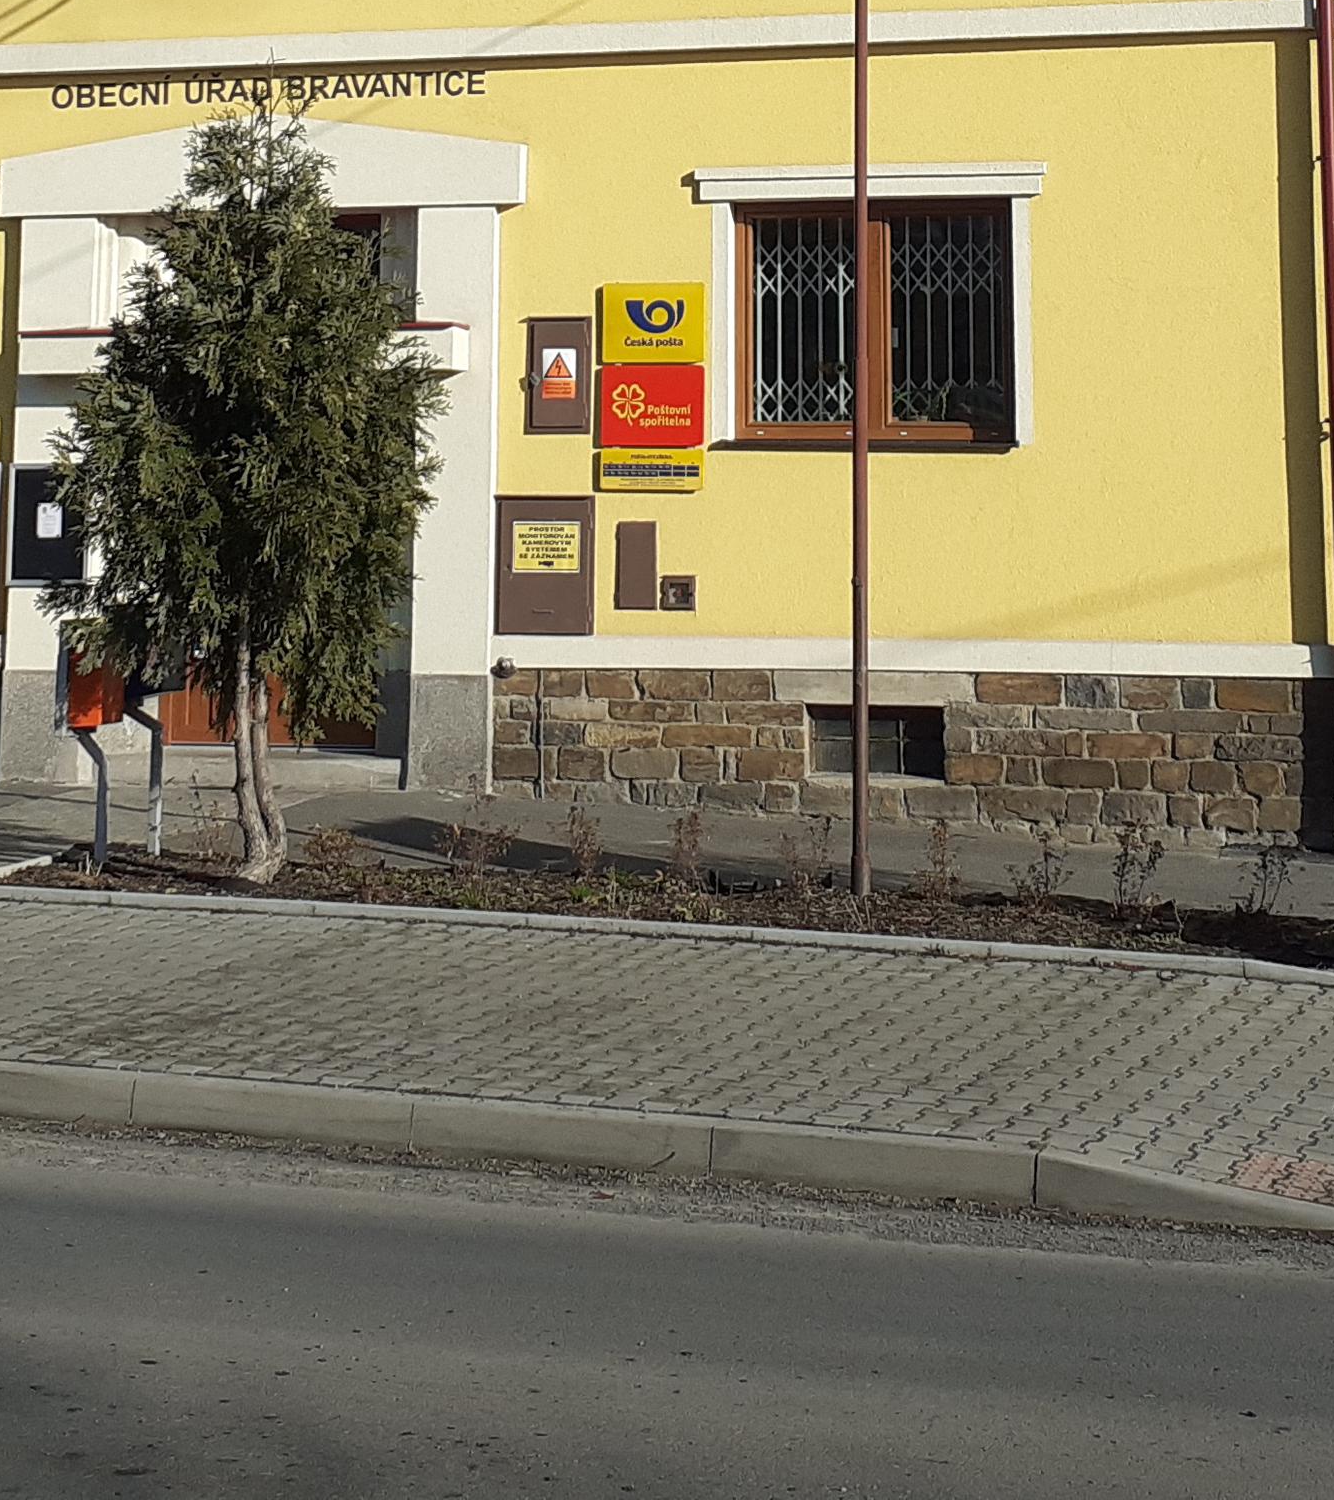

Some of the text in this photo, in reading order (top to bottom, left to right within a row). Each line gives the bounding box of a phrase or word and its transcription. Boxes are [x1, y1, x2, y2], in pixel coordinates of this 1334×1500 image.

[51, 70, 486, 109] OBECNÍ ÚŘAD BRAVANTICE
[624, 336, 684, 348] Česká pošta
[647, 404, 692, 415] Poštovní
[639, 415, 692, 428] spořitelna
